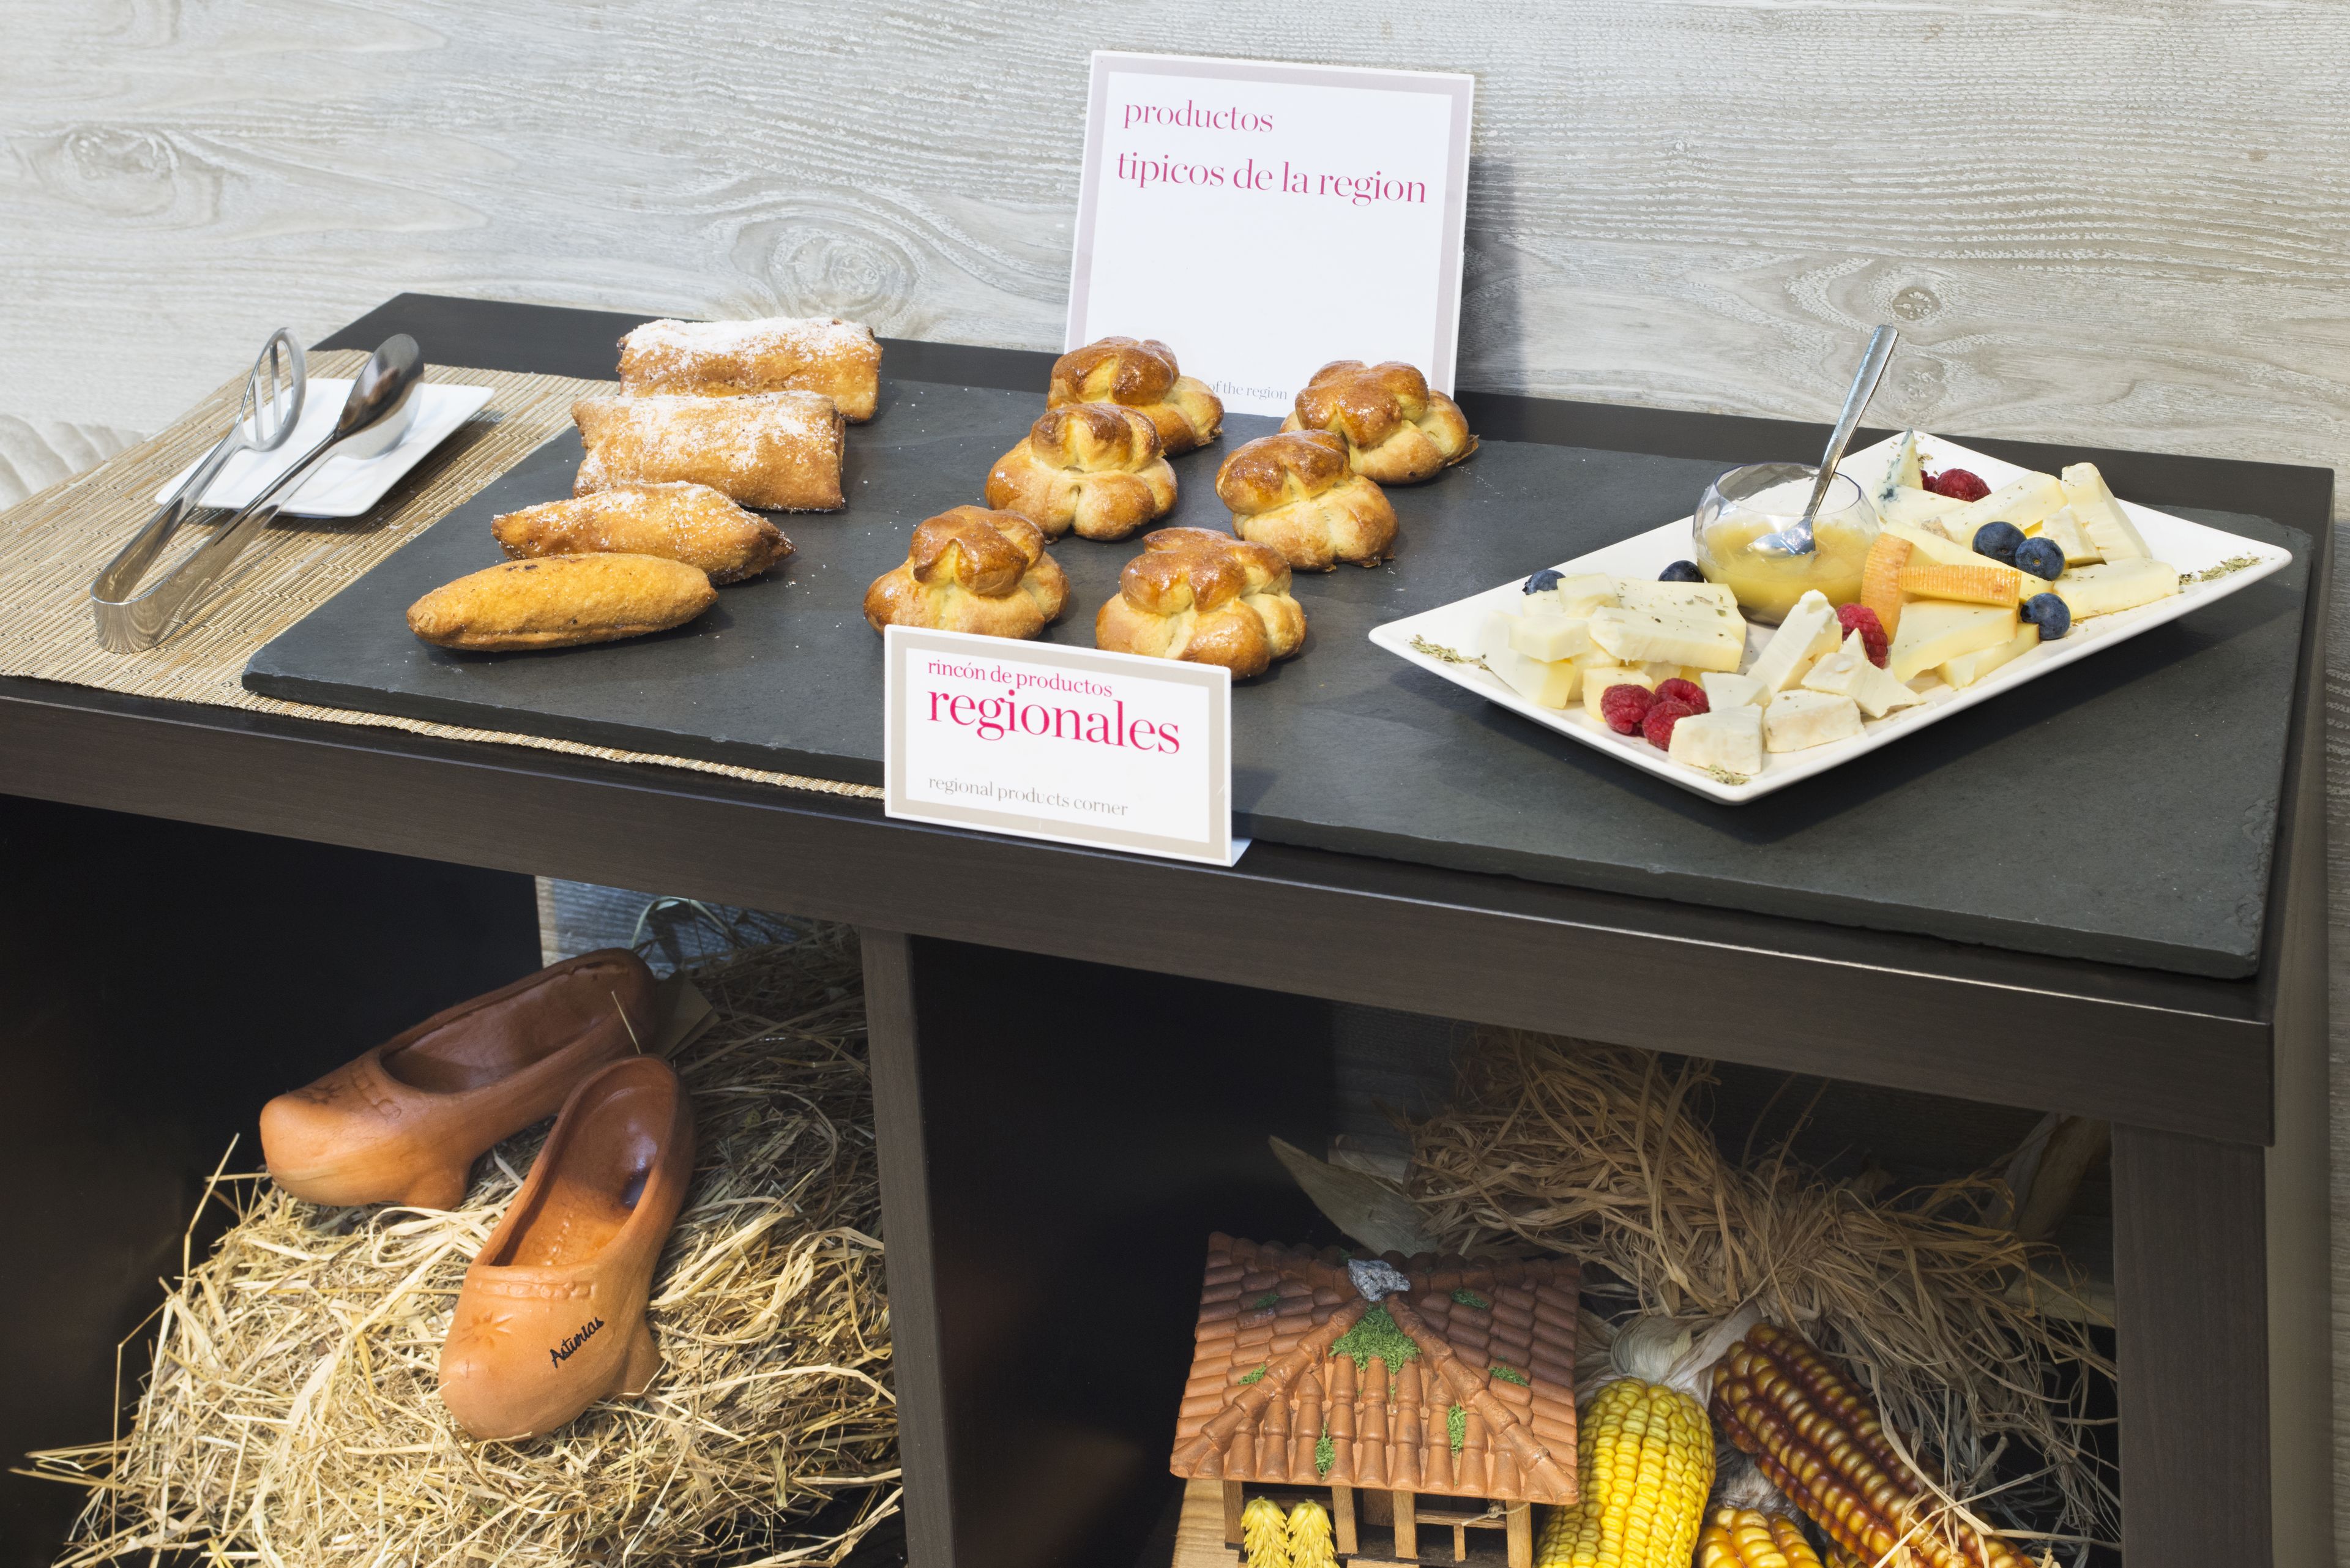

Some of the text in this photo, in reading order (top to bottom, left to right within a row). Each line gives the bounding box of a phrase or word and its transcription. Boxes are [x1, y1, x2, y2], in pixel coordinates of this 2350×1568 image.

[1123, 99, 1274, 133] productos
[1117, 151, 1427, 206] tipicos de la region
[1224, 381, 1244, 395] the
[1247, 386, 1288, 400] region
[928, 660, 1113, 698] rincón de productos
[927, 689, 1181, 755] regionales
[928, 777, 1128, 816] regional products corner
